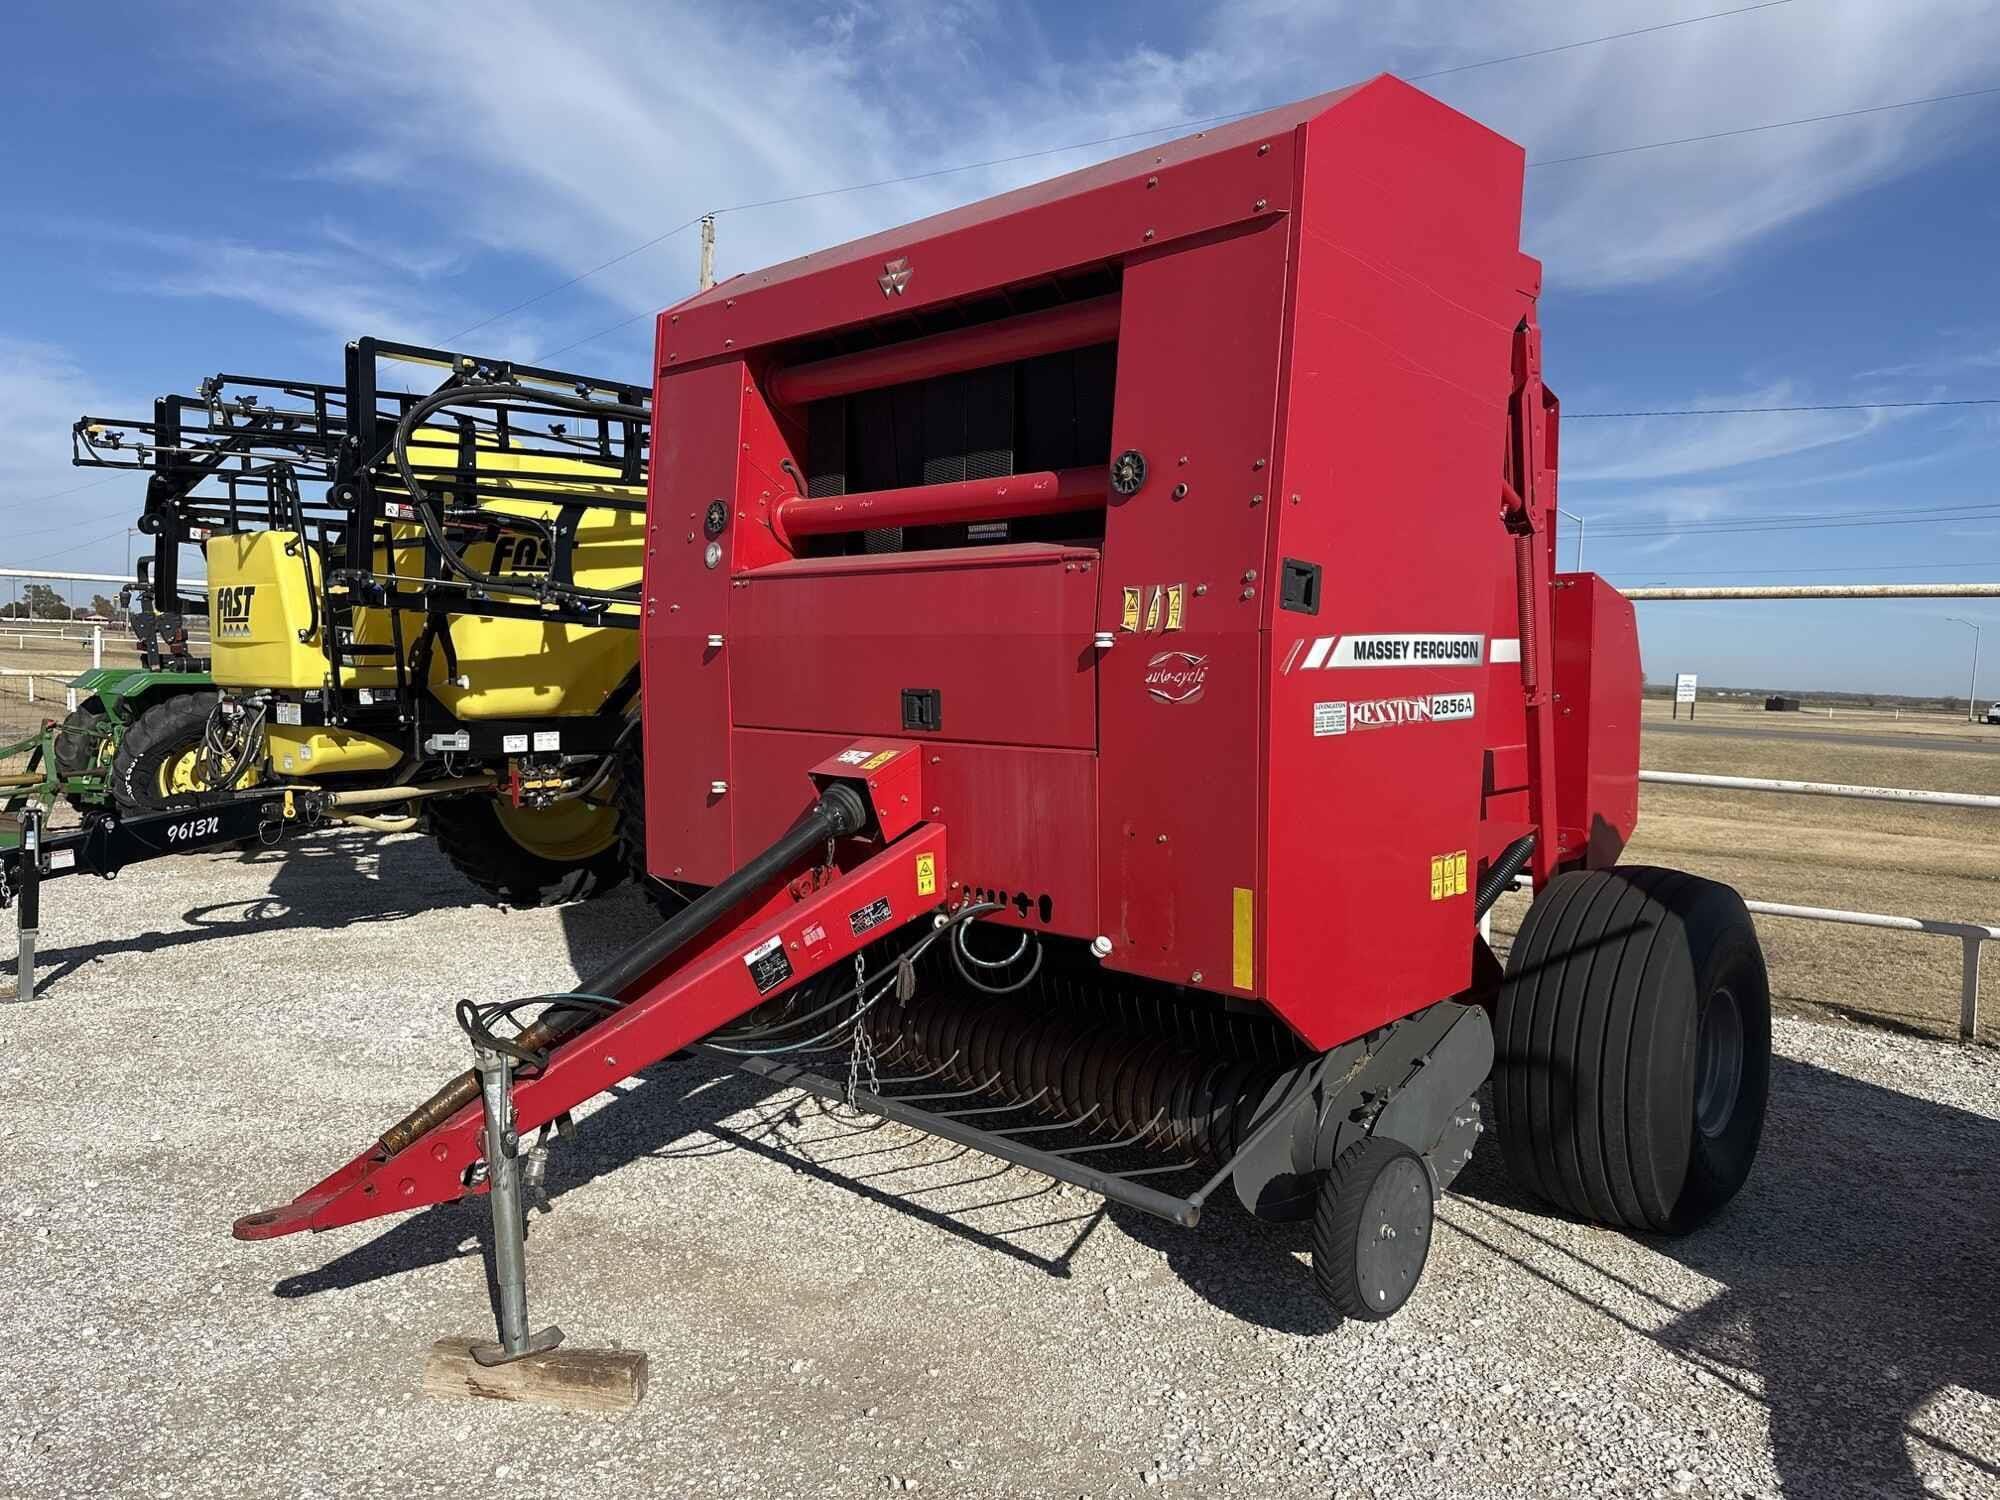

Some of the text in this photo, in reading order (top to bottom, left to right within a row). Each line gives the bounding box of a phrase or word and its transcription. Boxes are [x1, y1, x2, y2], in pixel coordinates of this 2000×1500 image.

[490, 536, 552, 576] FAS
[217, 586, 256, 638] FAST
[1353, 639, 1479, 661] MASSEY FERGUSON
[1433, 697, 1473, 715] 2856A
